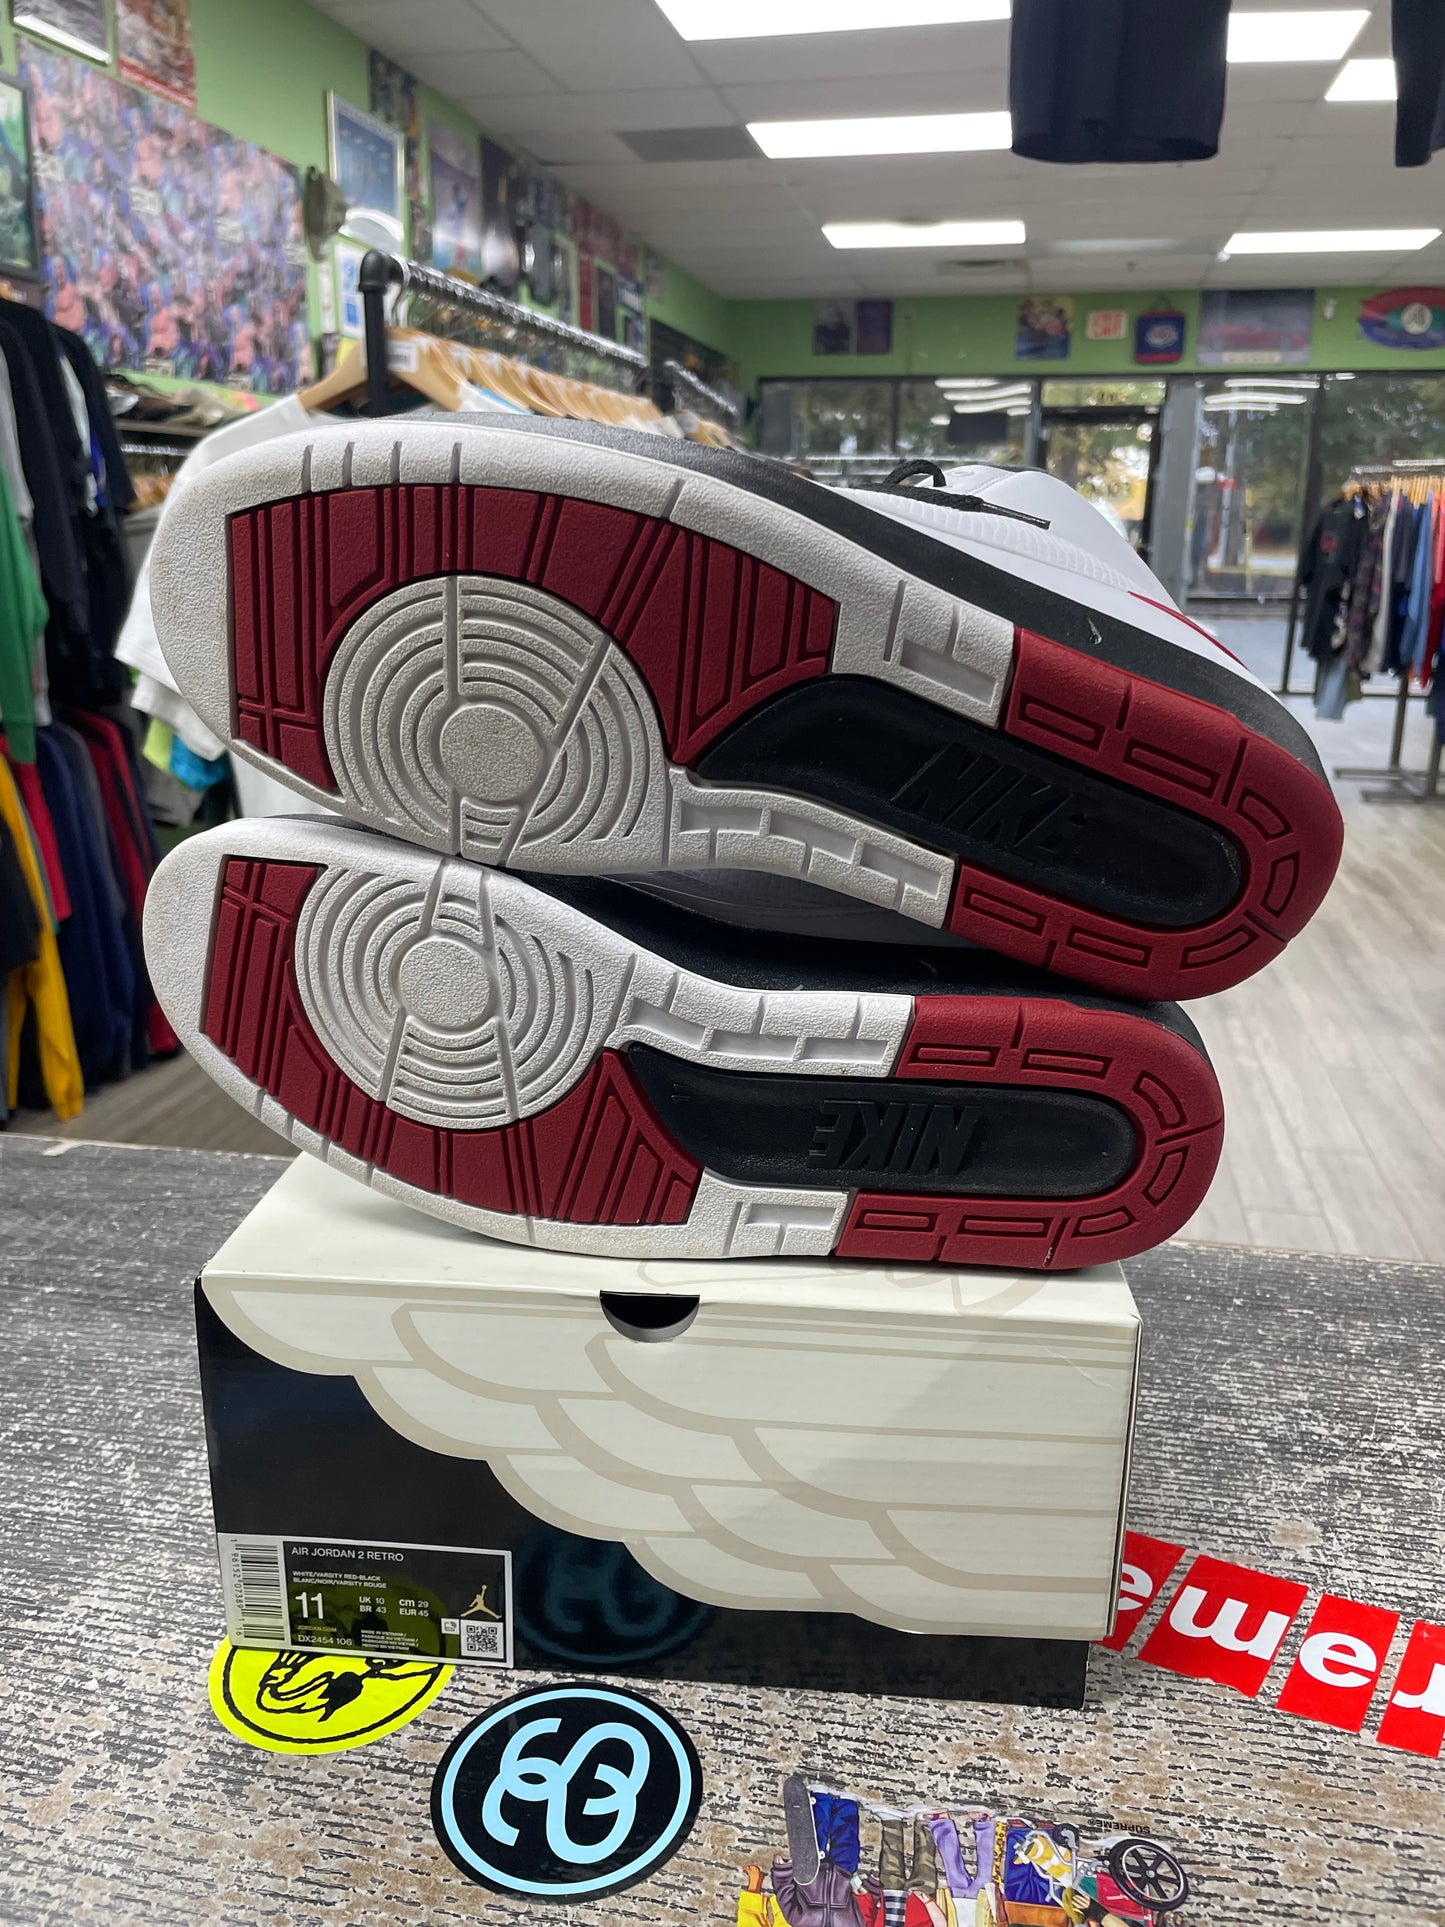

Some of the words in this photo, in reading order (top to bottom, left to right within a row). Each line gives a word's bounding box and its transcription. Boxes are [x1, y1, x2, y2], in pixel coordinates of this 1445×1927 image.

[889, 743, 1095, 862] NIKE
[807, 1099, 982, 1176] NIKE
[291, 1546, 309, 1556] AIR
[311, 1547, 356, 1559] JORDAN
[357, 1550, 365, 1560] 2
[366, 1551, 404, 1562] RETRO
[231, 1552, 241, 1579] 96152
[292, 1570, 343, 1579] WHITE/VARSITY
[343, 1573, 381, 1582] RED-BLACK
[233, 1583, 244, 1609] 07389
[359, 1596, 372, 1604] UK
[375, 1597, 385, 1605] 10
[399, 1598, 415, 1607] cm
[417, 1600, 429, 1608] 29
[295, 1591, 324, 1619] 11
[359, 1605, 372, 1613] BR
[375, 1606, 387, 1614] 43
[399, 1608, 417, 1616] EUR
[418, 1609, 429, 1617] 45
[298, 1634, 334, 1644] DX2454
[336, 1637, 352, 1646] 106
